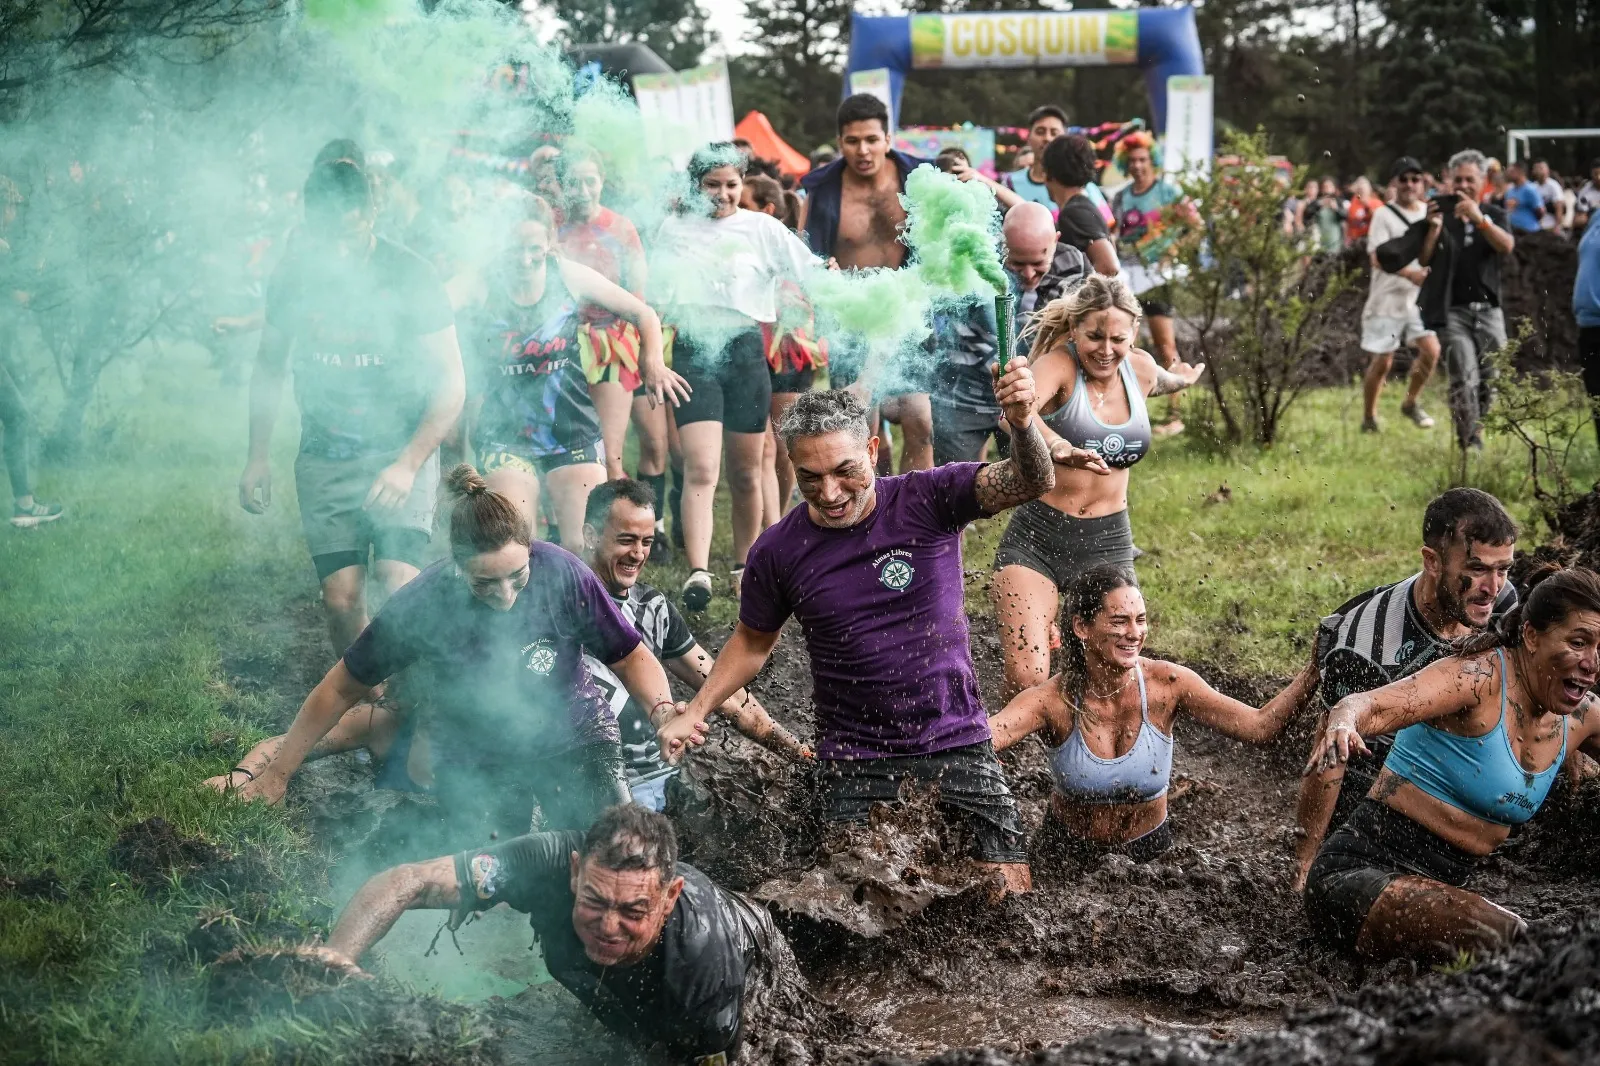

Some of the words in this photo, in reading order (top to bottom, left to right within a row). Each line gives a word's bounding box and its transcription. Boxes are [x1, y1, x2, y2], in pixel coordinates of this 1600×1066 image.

[952, 16, 1099, 57] COSQUIN
[499, 331, 567, 358] Team
[872, 552, 890, 569] Almas
